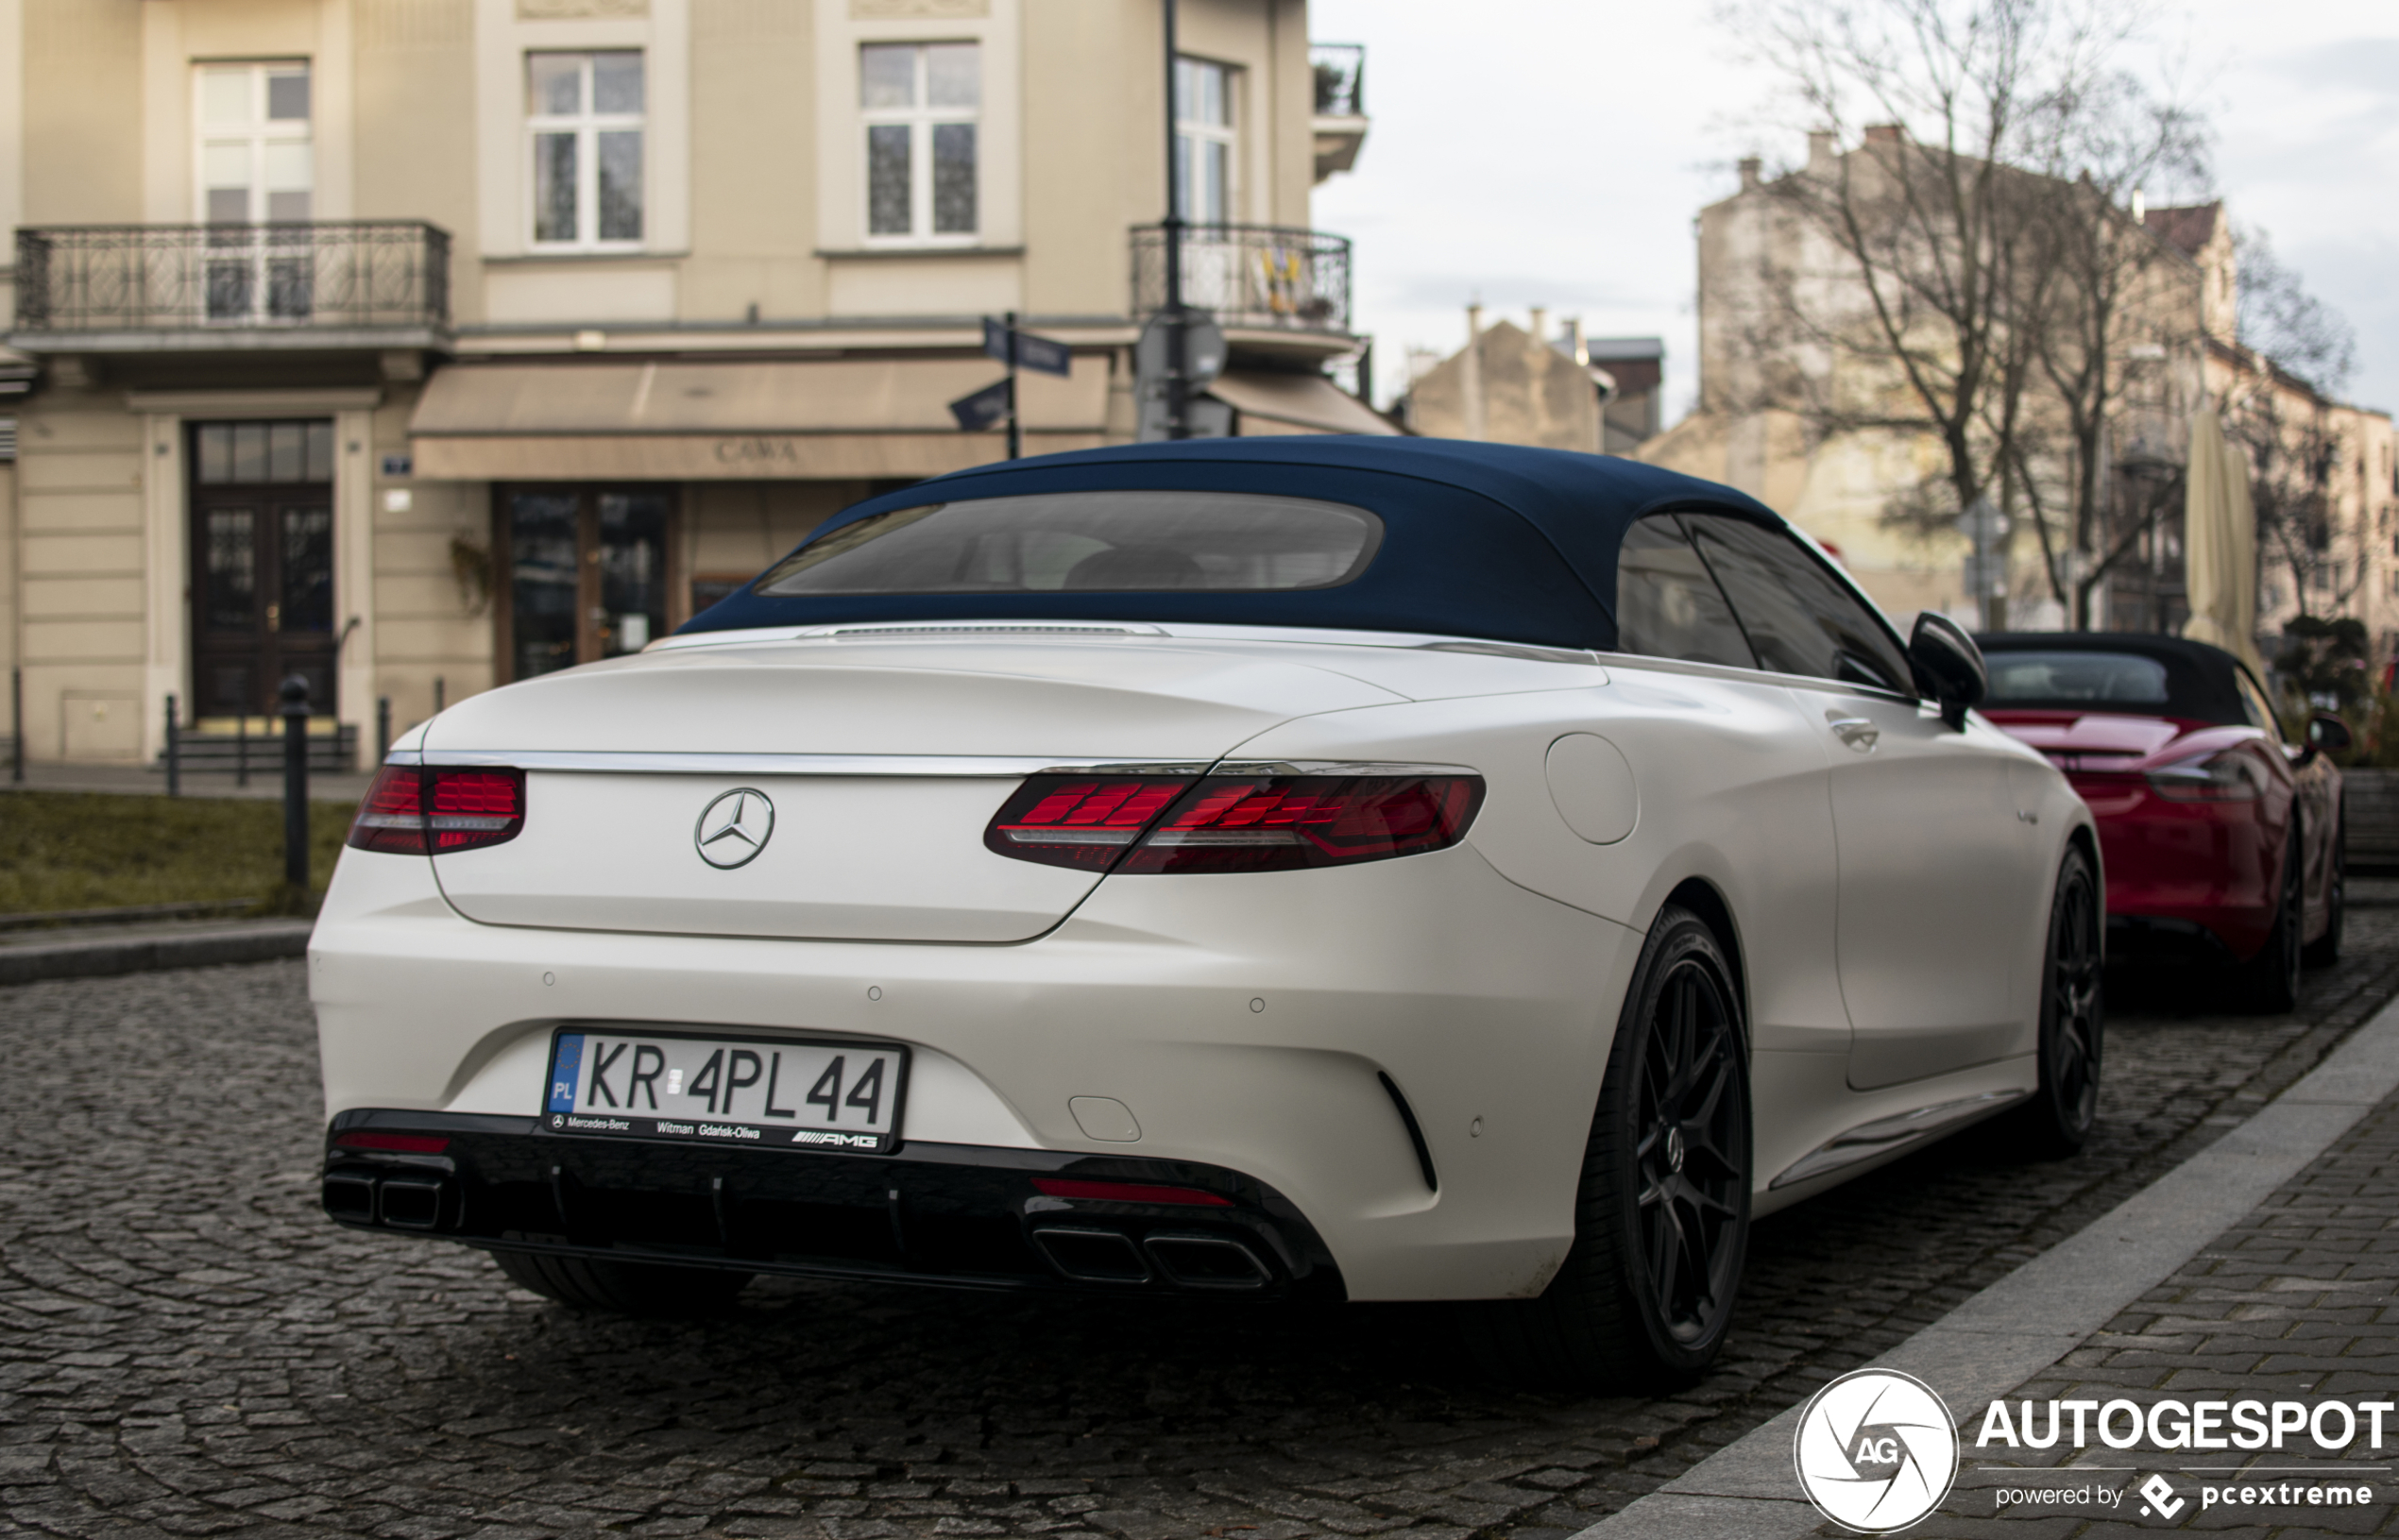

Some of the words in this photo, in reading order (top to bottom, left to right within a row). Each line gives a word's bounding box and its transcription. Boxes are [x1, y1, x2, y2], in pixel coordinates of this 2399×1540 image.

[553, 1082, 572, 1099] PL
[587, 1042, 666, 1109] KR
[688, 1048, 886, 1125] 4PL44
[568, 1117, 630, 1130] Mercedes-Benz
[656, 1121, 694, 1134] Witman
[699, 1124, 760, 1139] Gdańsk-Oliwa
[819, 1133, 878, 1148] AMG
